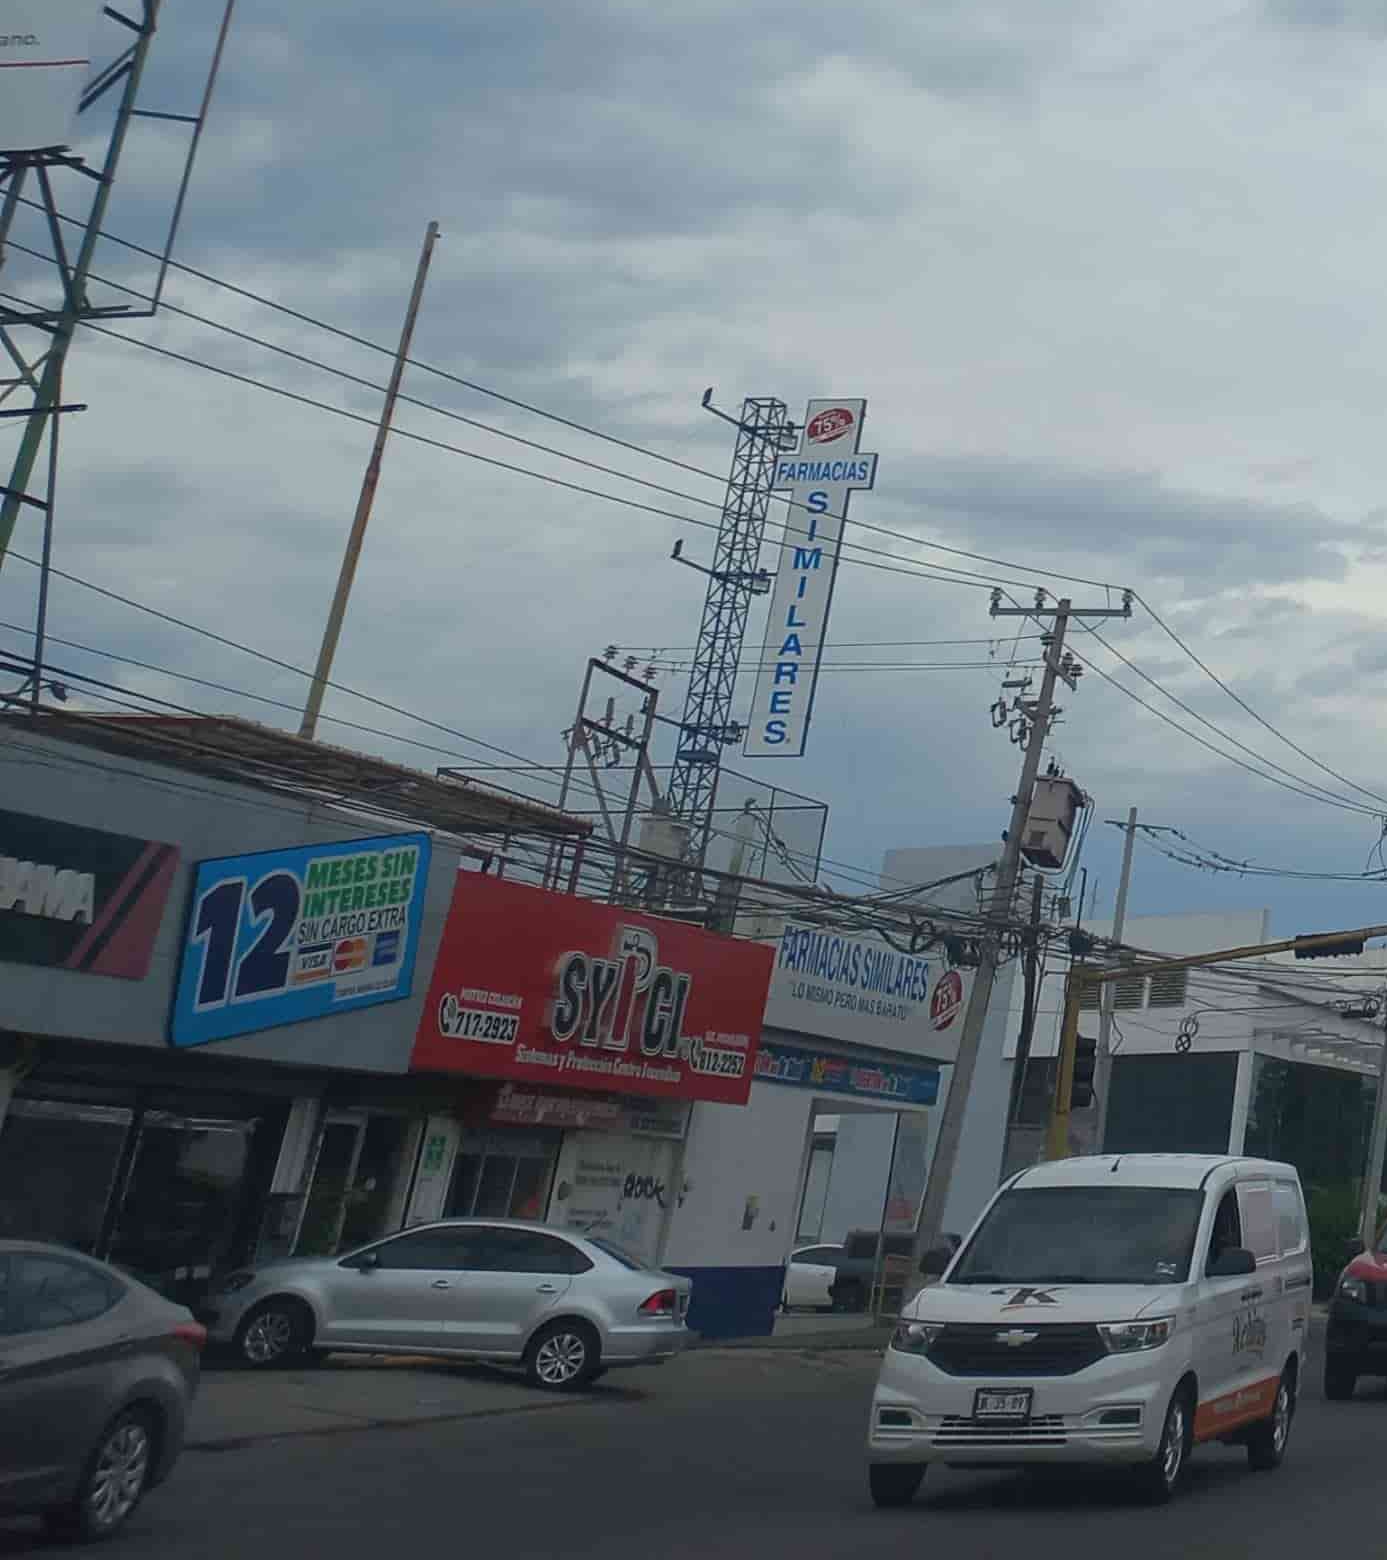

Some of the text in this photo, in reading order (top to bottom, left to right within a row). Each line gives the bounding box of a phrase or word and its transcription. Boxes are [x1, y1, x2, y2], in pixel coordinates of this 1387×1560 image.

[777, 460, 868, 482] FARMACIAS
[763, 491, 829, 744] SIMILARES
[307, 849, 418, 889] MESES SIN
[303, 877, 411, 919] INTERESES
[193, 871, 303, 1007] 12
[298, 905, 407, 944] SIN CARGO EXTRA
[301, 957, 328, 970] VISA
[780, 926, 930, 1002] FARMACIAS SIMILARES
